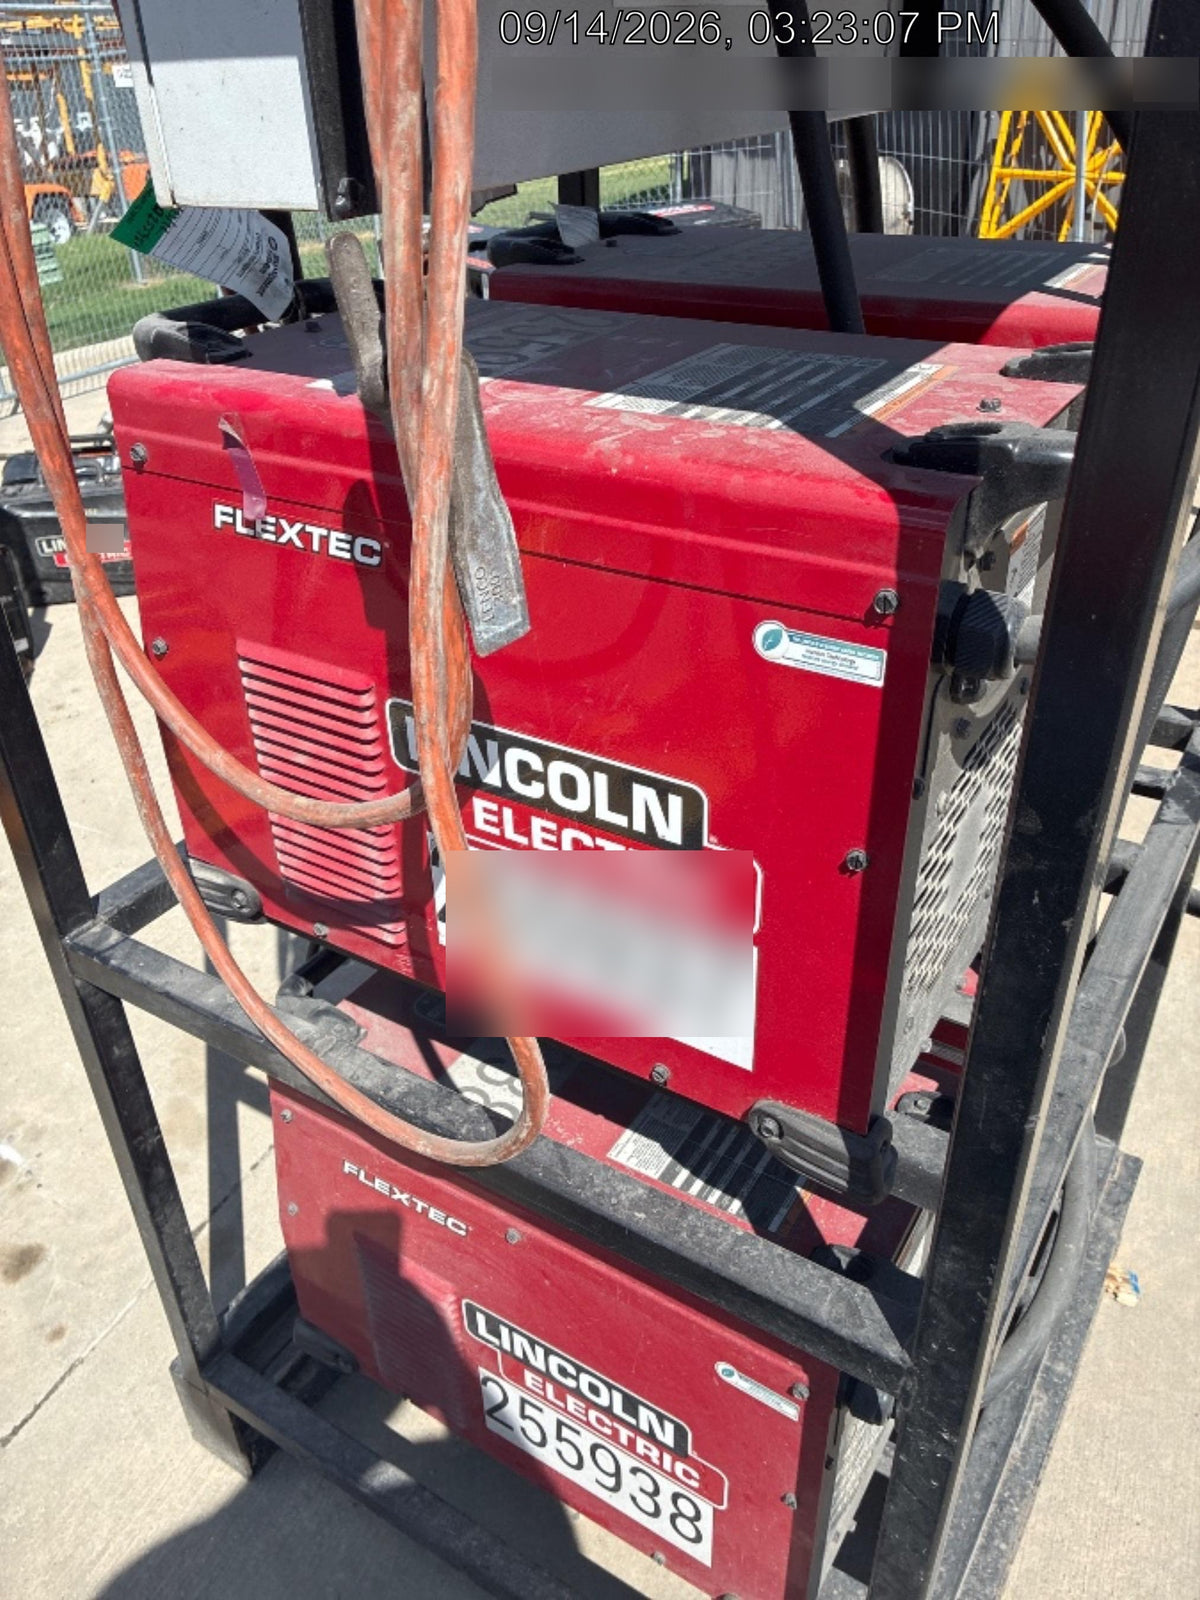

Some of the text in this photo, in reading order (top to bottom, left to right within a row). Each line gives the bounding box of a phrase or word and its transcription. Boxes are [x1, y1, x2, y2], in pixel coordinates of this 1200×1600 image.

[213, 503, 383, 565] FLEXTEC
[404, 715, 683, 846] NCOLN
[342, 1161, 468, 1237] FLEXTEC
[475, 1310, 676, 1450] LINCOLN
[523, 1373, 701, 1489] ELECTRIC
[480, 1375, 705, 1546] 255938
